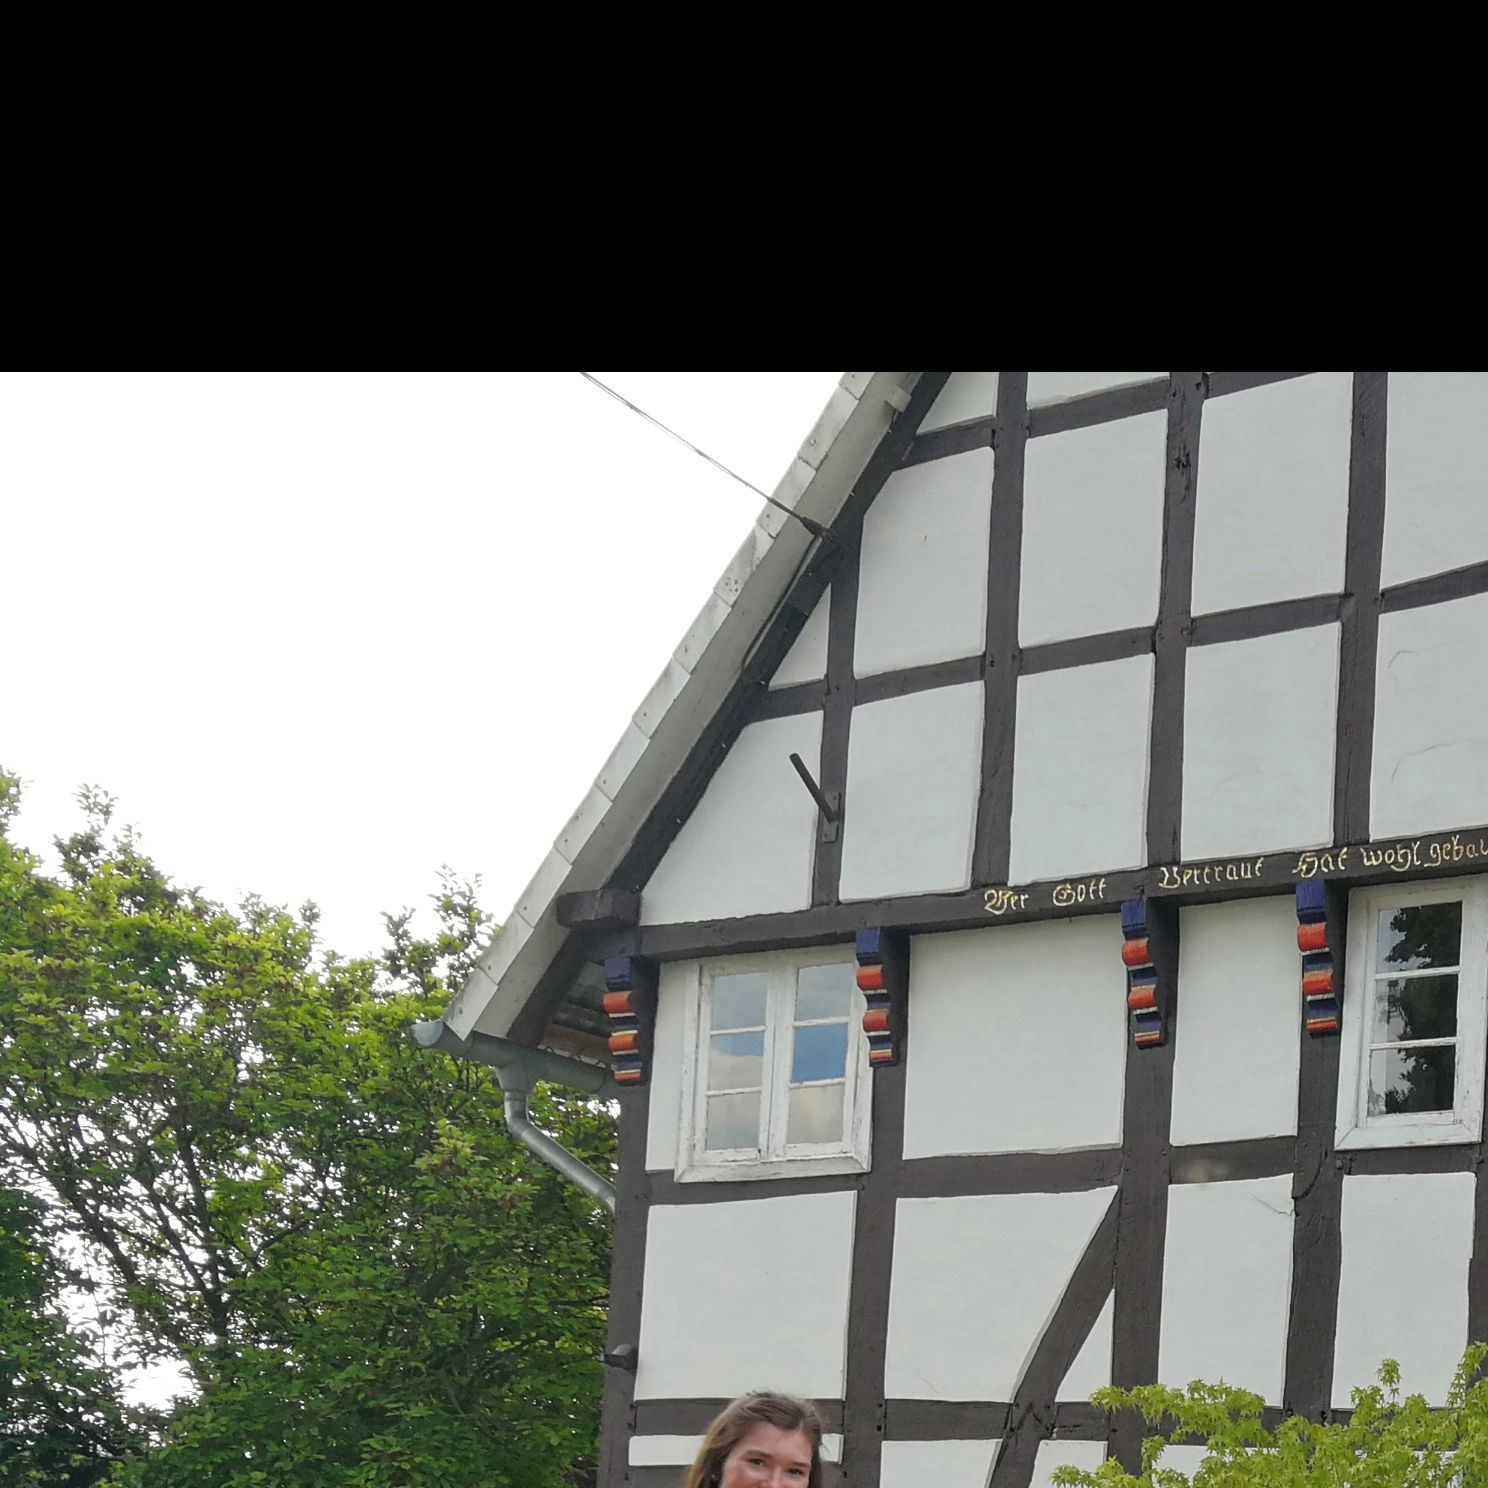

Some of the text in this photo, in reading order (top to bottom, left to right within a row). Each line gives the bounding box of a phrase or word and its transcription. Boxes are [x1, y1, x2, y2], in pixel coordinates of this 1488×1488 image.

[1053, 878, 1106, 906] Gott
[1158, 857, 1264, 889] Vertraut
[1360, 840, 1421, 872] wohl
